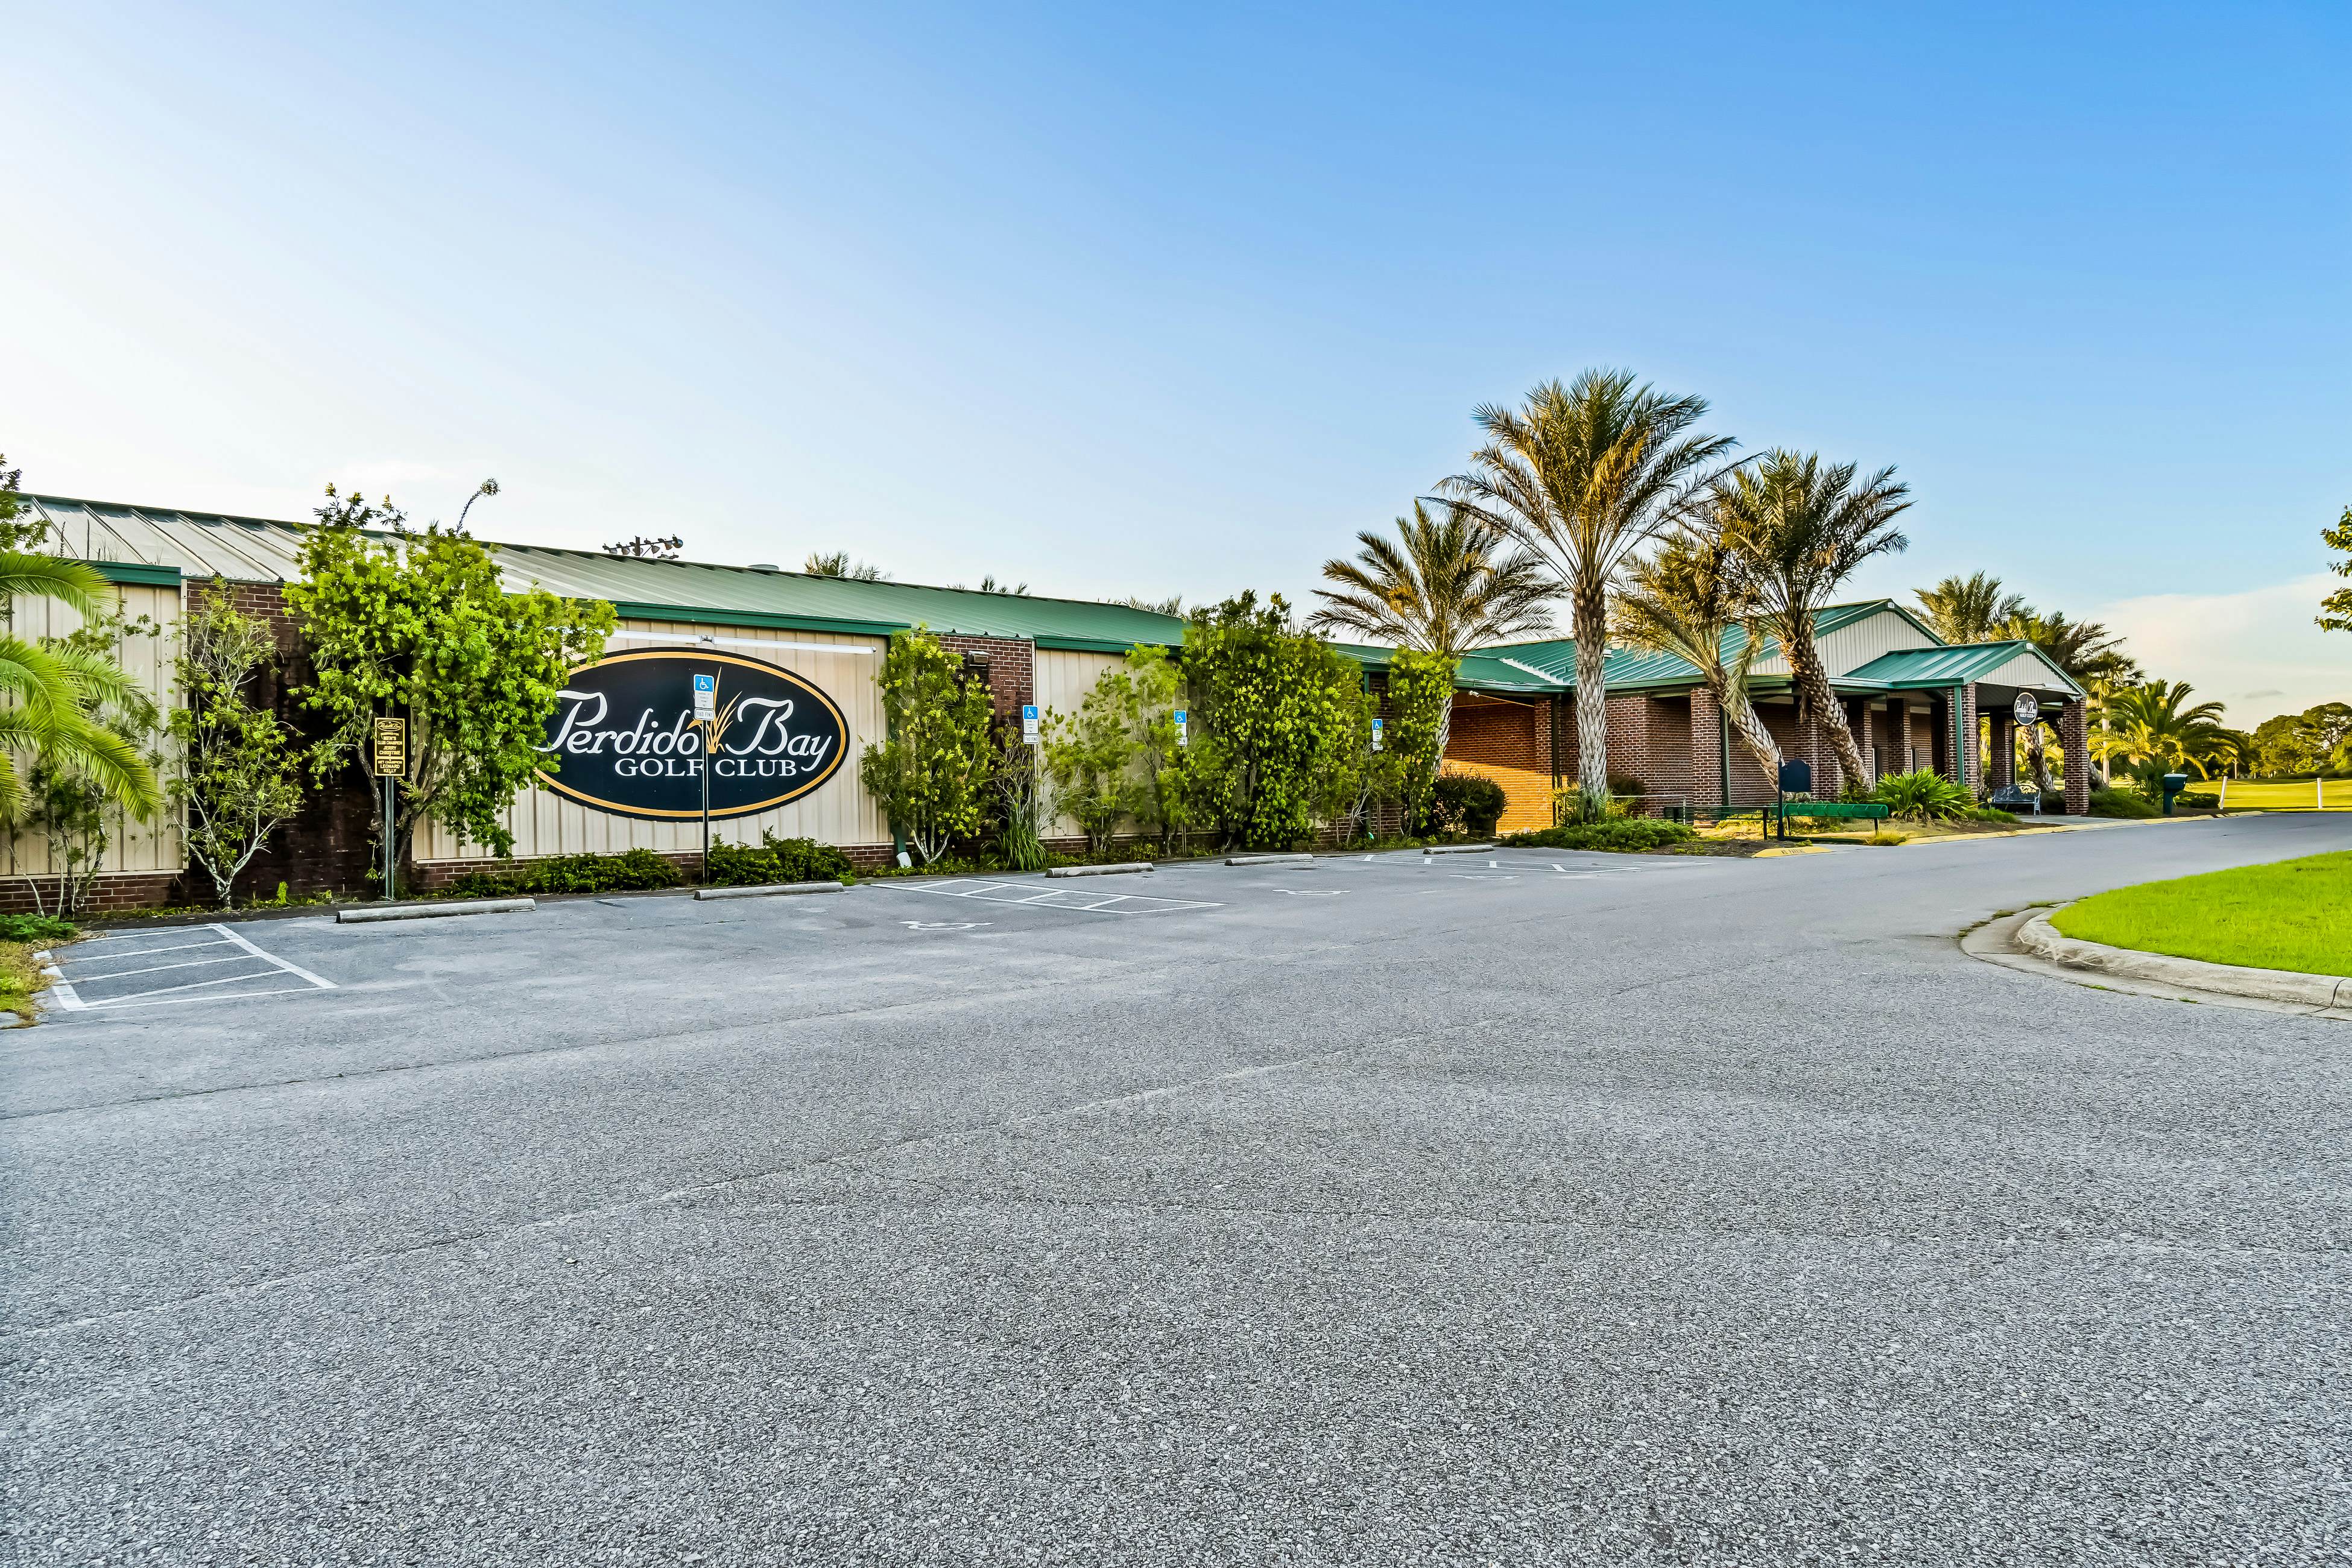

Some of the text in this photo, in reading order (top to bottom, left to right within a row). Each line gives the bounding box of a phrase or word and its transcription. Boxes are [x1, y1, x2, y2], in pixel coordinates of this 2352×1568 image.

[530, 691, 832, 772] Perdido Bay
[615, 758, 797, 777] GOLF CLUB
